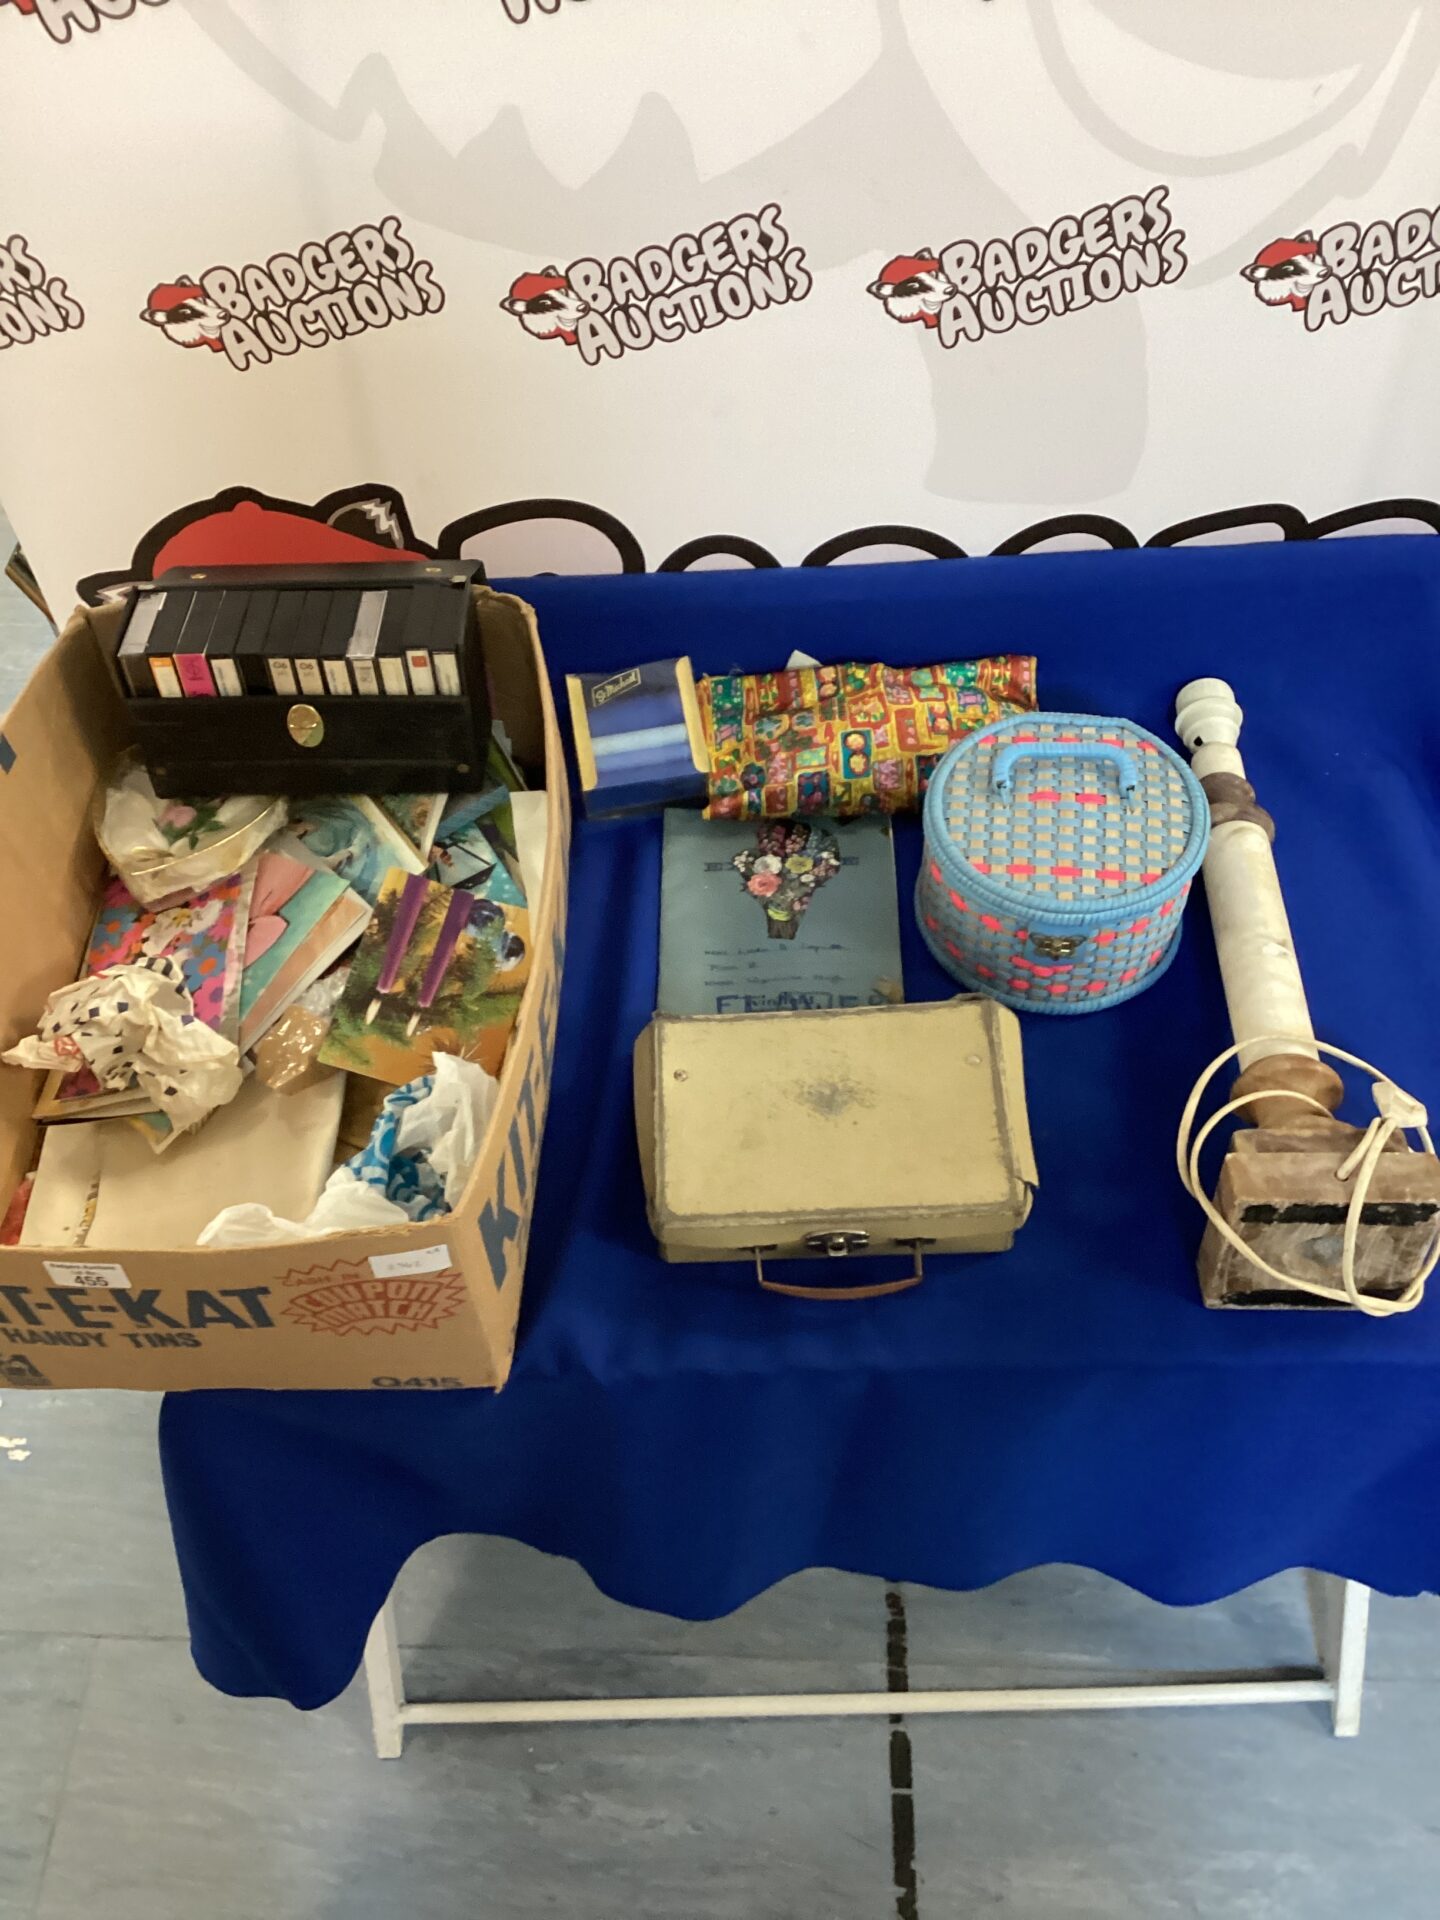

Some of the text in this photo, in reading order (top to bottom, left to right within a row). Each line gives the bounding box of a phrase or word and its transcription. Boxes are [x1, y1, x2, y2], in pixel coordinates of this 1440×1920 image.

[200, 215, 414, 320] BADGERS
[566, 203, 788, 314] BADGERS
[938, 229, 1187, 349] AUCTIONS
[939, 185, 1172, 297] BADGERS
[1319, 204, 1440, 280] BAD
[221, 260, 445, 371] AUCTIONS
[577, 247, 812, 365] AUCTIONS
[74, 1275, 109, 1287] 455
[1, 1327, 203, 1349] HANDY TINS
